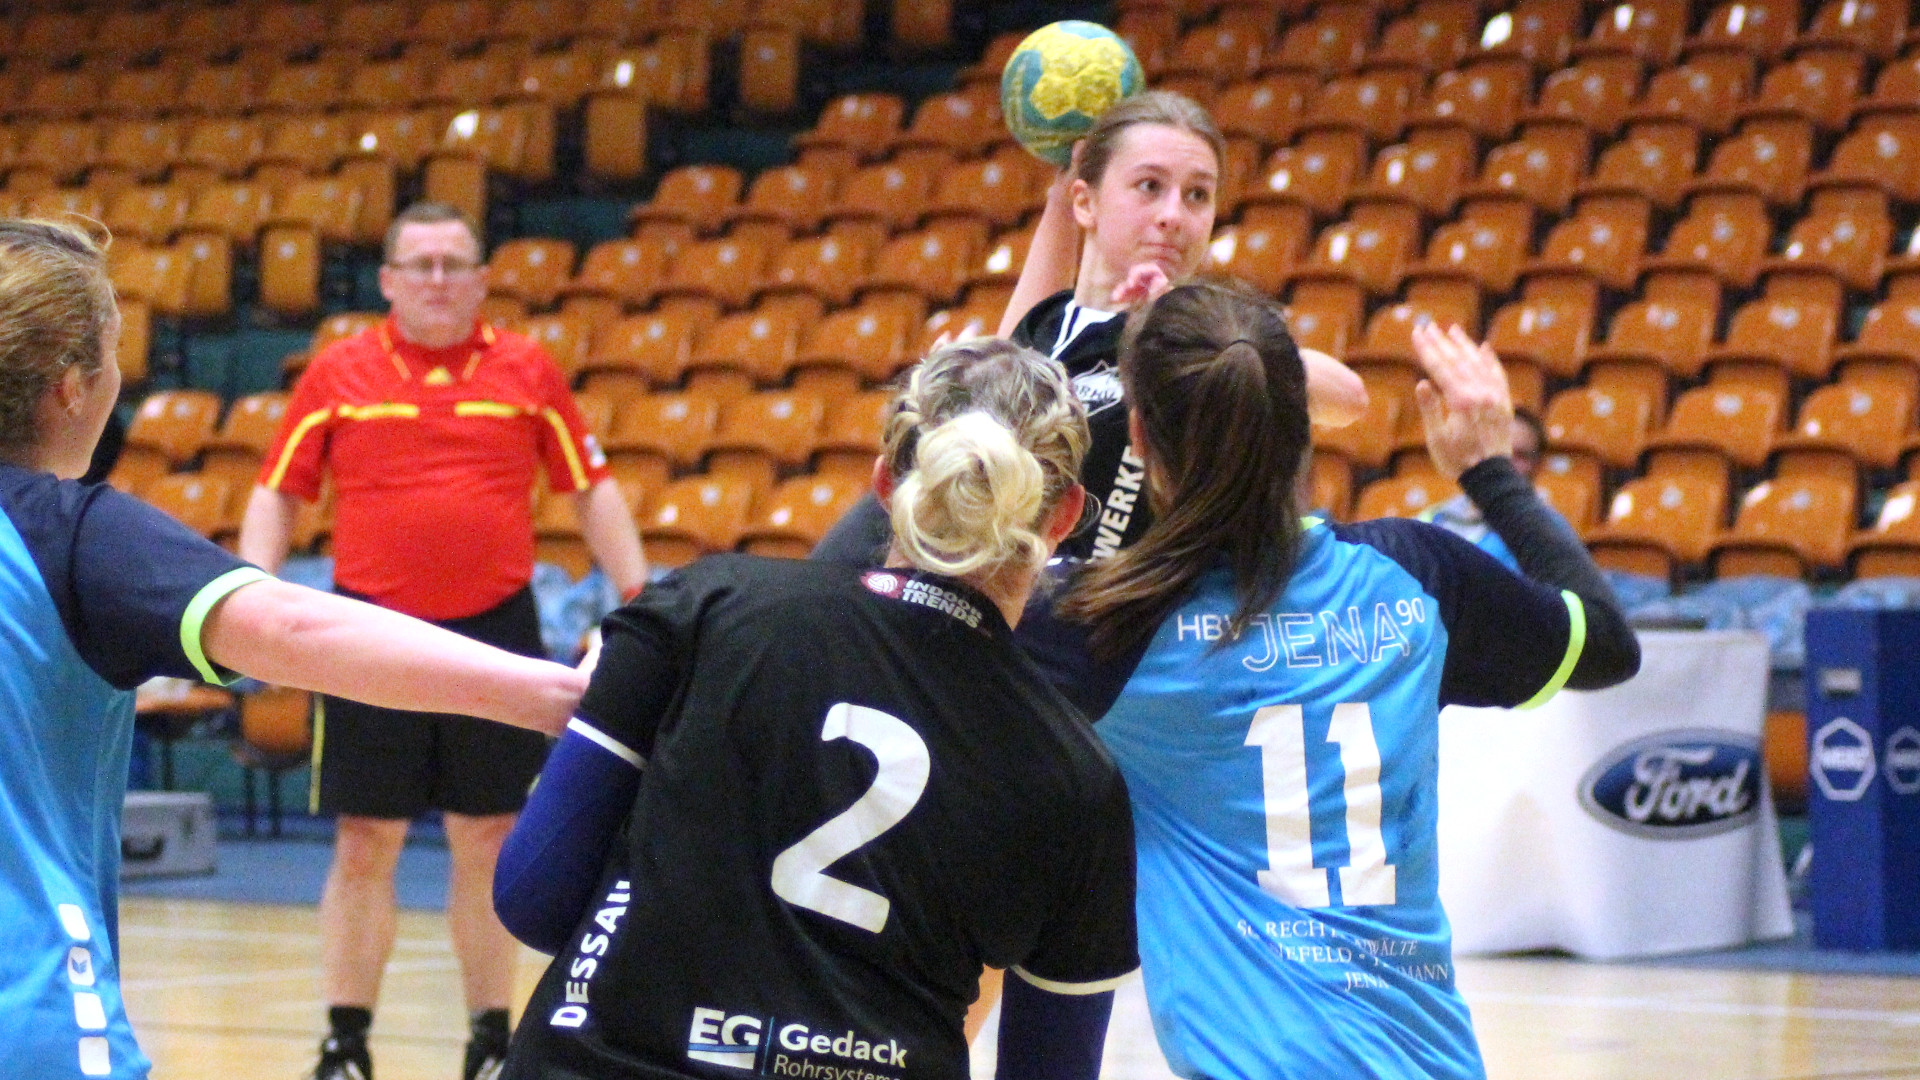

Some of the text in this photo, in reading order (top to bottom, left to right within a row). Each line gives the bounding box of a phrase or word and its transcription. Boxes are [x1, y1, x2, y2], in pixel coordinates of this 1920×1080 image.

[902, 588, 979, 628] TRENDS
[905, 579, 982, 621] INDOOR
[1242, 602, 1410, 672] JENA
[1244, 702, 1396, 908] 11
[1624, 748, 1751, 821] Ford
[770, 702, 931, 935] 2
[688, 1006, 908, 1069] EG Gedack
[773, 1053, 901, 1080] Rohrsyste
